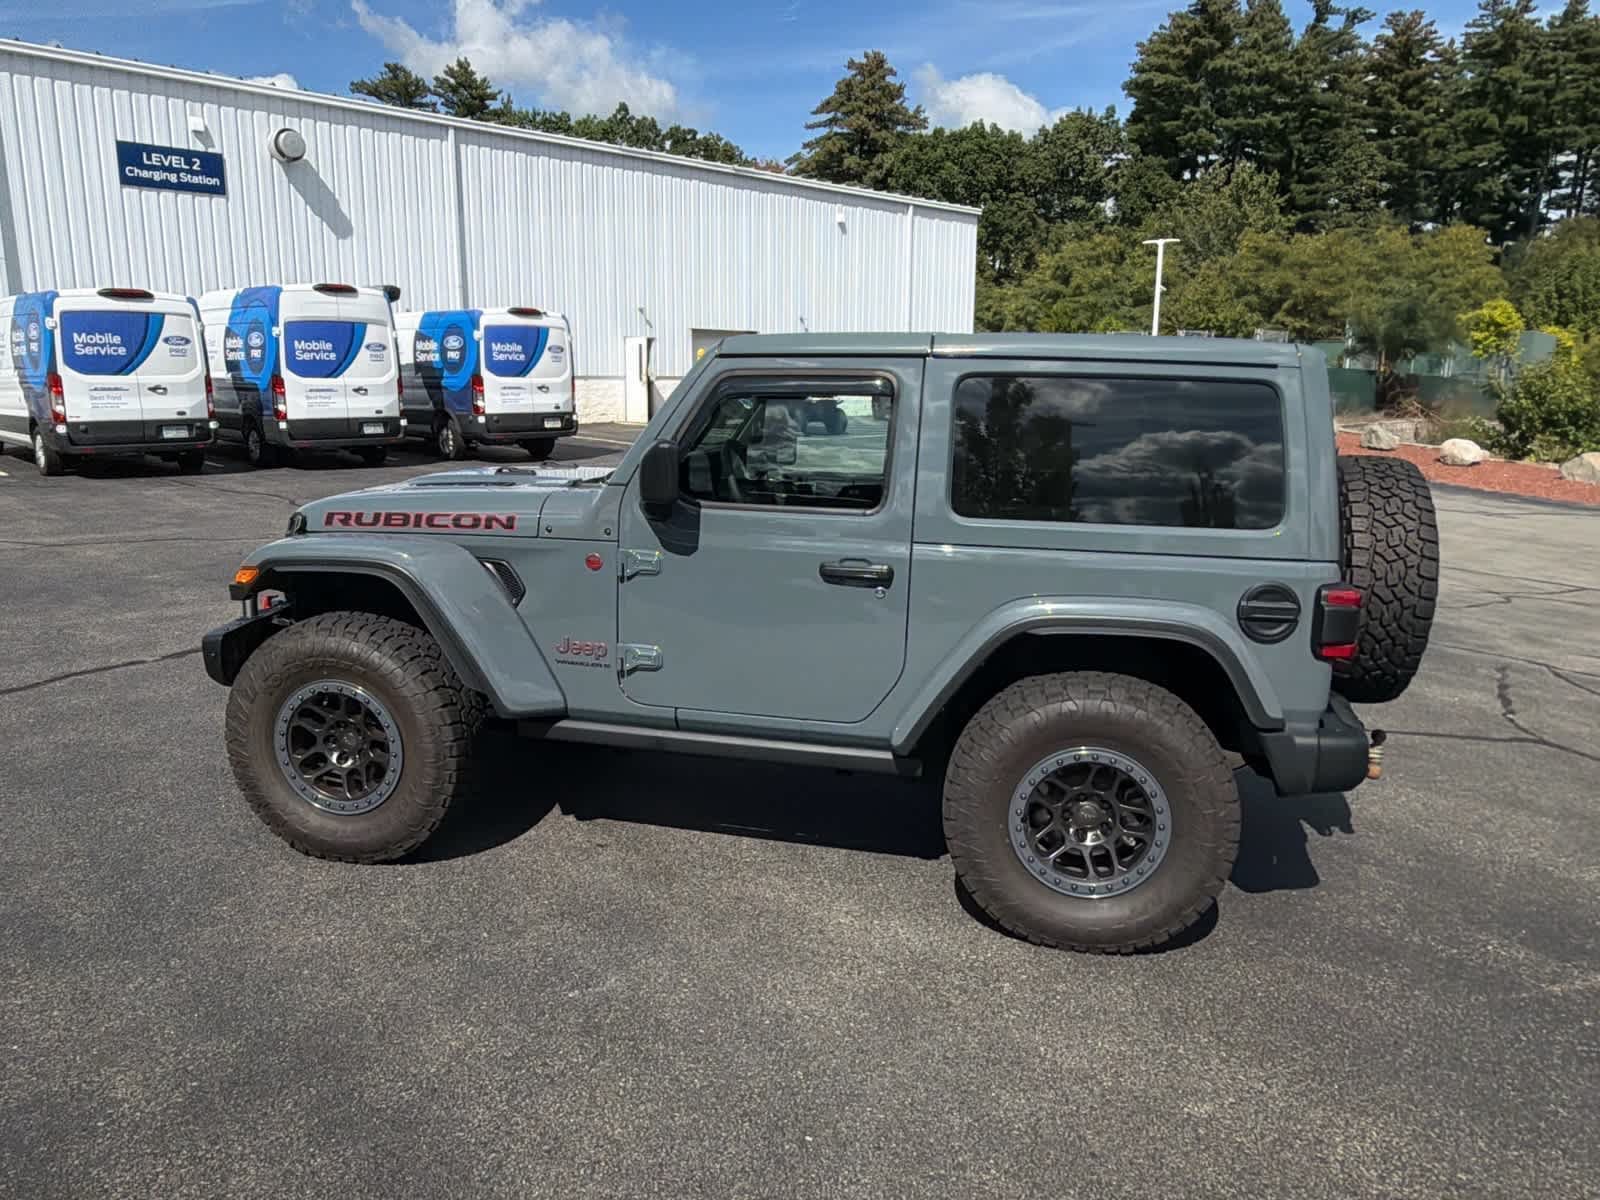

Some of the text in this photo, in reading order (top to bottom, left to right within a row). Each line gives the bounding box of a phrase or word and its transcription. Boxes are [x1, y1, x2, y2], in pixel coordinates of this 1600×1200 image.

[143, 152, 201, 170] LEVEL 2
[125, 166, 220, 186] Charging Station
[73, 332, 122, 345] Mobile
[75, 344, 127, 356] Service
[294, 339, 333, 351] Mobile
[415, 340, 438, 351] Mobile
[491, 342, 523, 352] Mobile
[295, 350, 337, 361] Service
[415, 351, 440, 362] Service
[492, 352, 526, 361] Service
[323, 512, 516, 530] RUBICON
[555, 635, 608, 661] Jeep
